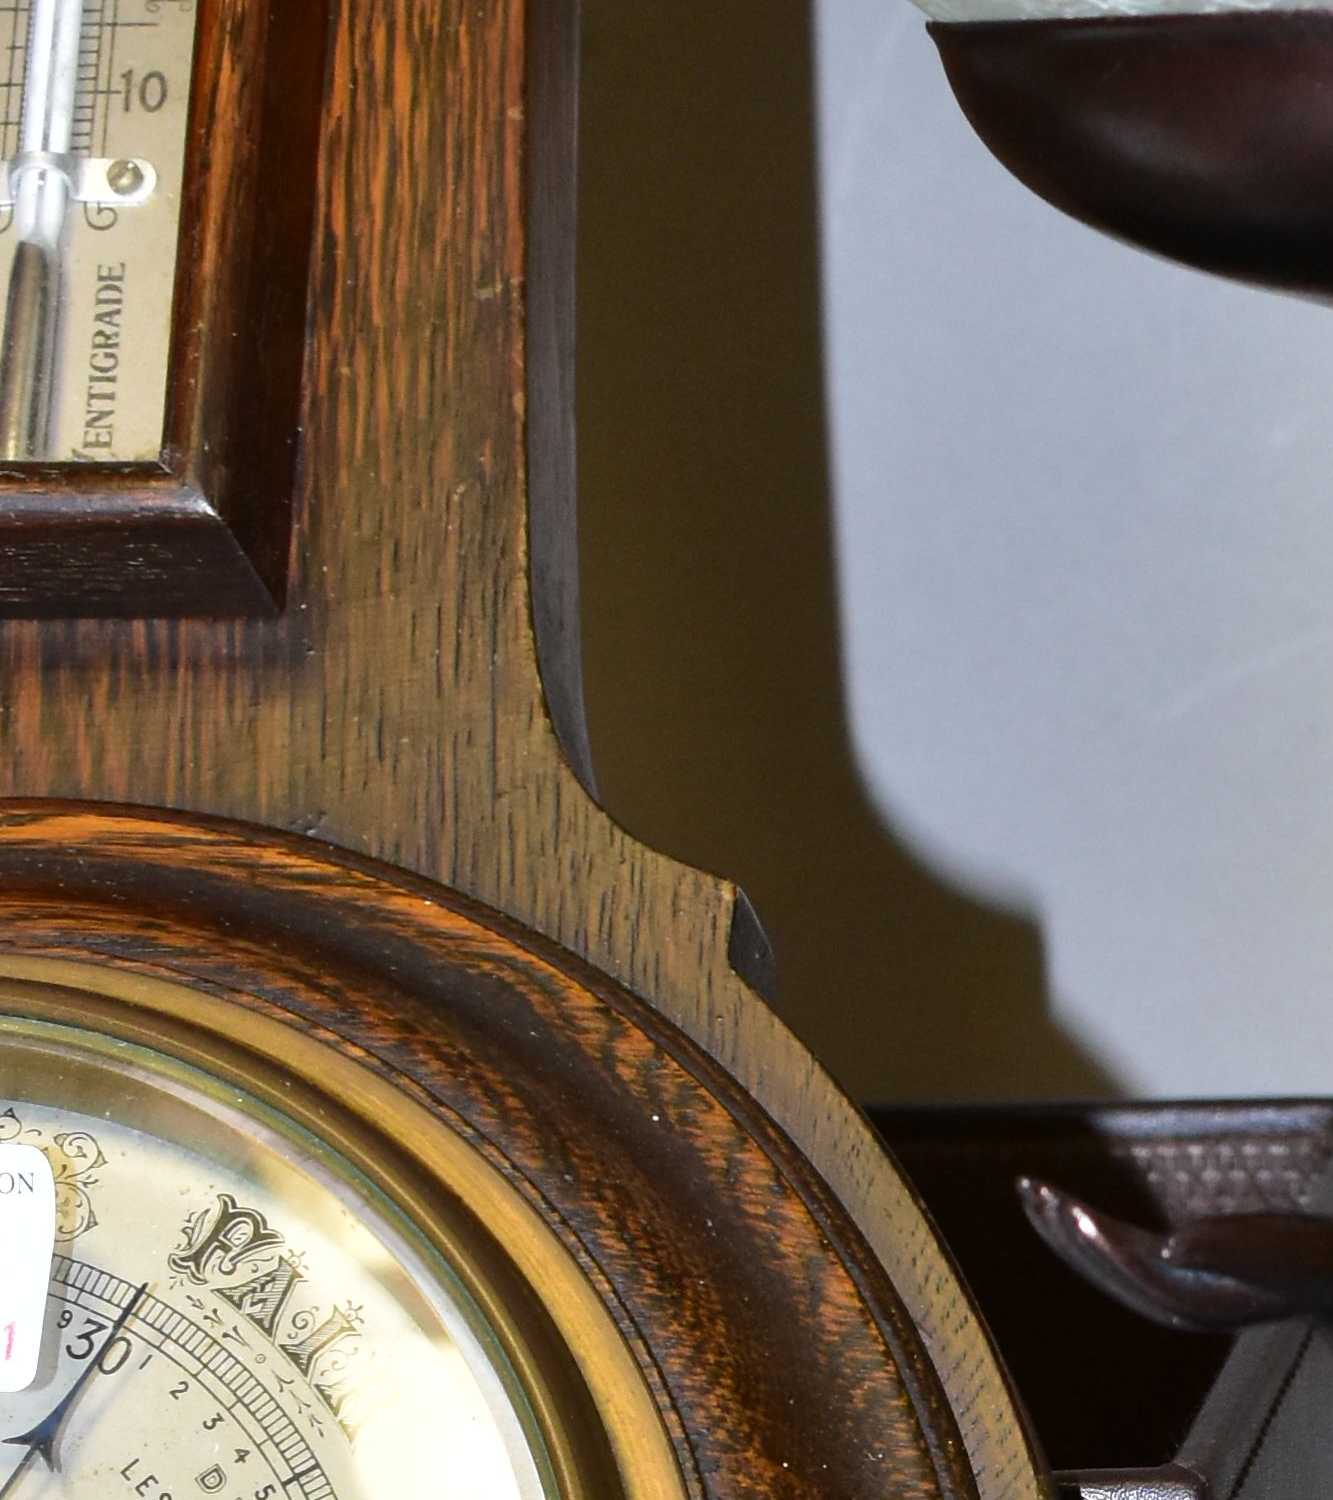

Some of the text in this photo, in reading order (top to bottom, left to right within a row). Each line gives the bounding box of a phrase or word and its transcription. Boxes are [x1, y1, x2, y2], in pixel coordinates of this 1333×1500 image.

[121, 68, 168, 113] 10
[57, 1309, 73, 1329] 9
[65, 1319, 132, 1376] 30
[139, 1354, 153, 1370] 1
[169, 1380, 190, 1400] 2
[203, 1412, 225, 1431] 3
[233, 1447, 251, 1465] 4
